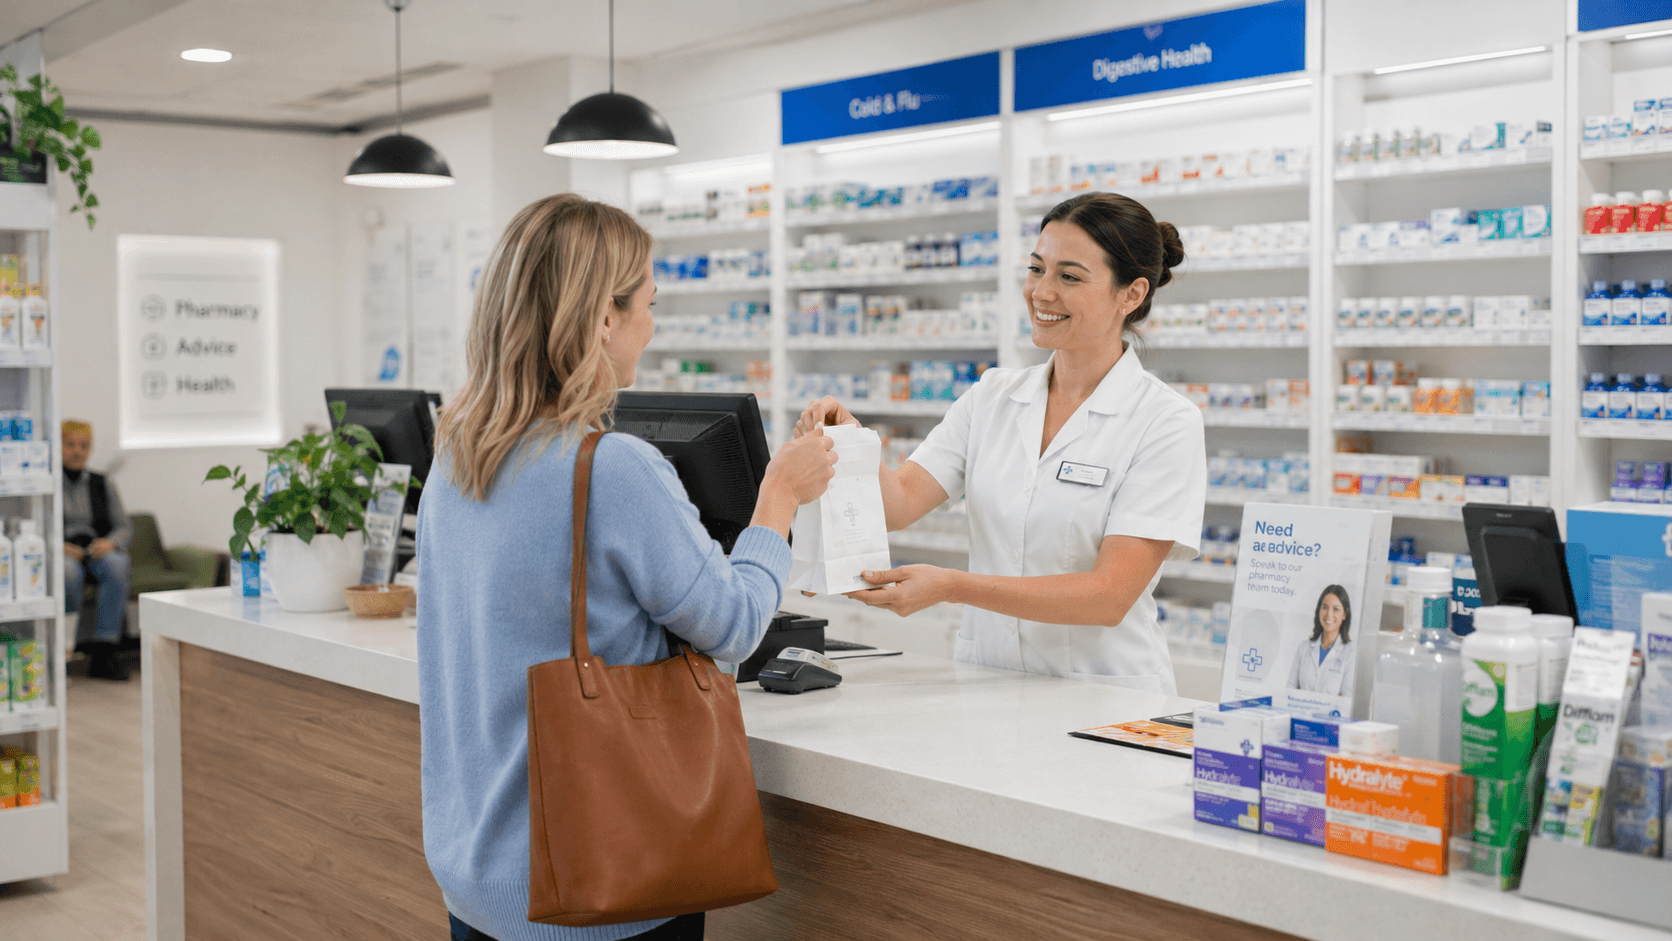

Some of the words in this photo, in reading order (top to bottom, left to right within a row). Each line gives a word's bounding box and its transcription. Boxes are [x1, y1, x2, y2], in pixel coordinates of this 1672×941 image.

[1092, 53, 1160, 83] Digestive
[1161, 41, 1212, 69] Health
[176, 299, 259, 323] Pharmacy
[176, 337, 237, 357] Advice
[176, 375, 236, 395] Health
[1255, 521, 1293, 537] Need
[1250, 558, 1276, 572] Speak
[1278, 562, 1287, 571] to
[1288, 564, 1303, 572] our
[1248, 583, 1269, 593] team
[1563, 704, 1615, 723] Difflam
[1328, 761, 1403, 791] Hydralyte
